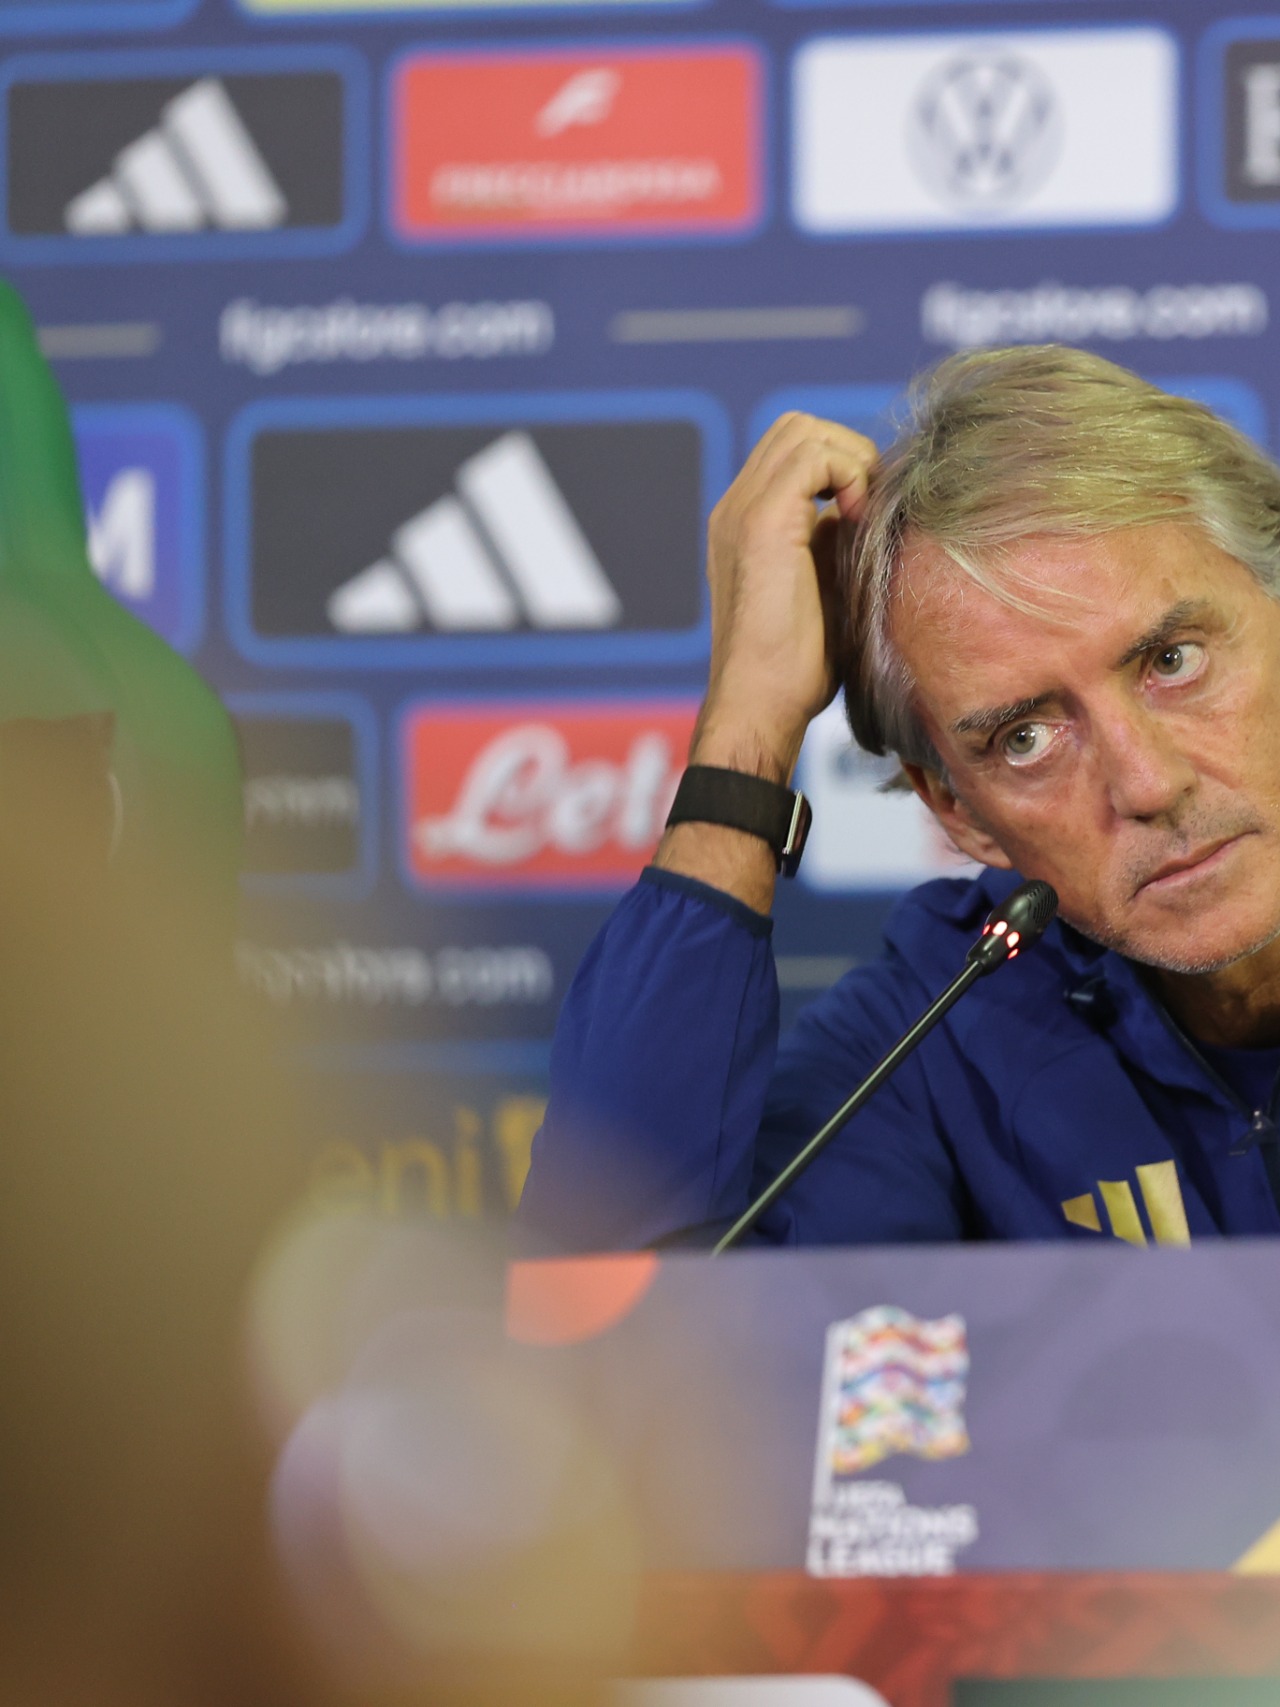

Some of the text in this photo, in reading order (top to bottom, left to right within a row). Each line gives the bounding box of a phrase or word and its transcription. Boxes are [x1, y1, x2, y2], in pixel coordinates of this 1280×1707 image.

[219, 299, 556, 376] figcstore.com
[921, 281, 1268, 346] figcstore.com
[413, 723, 692, 866] Let
